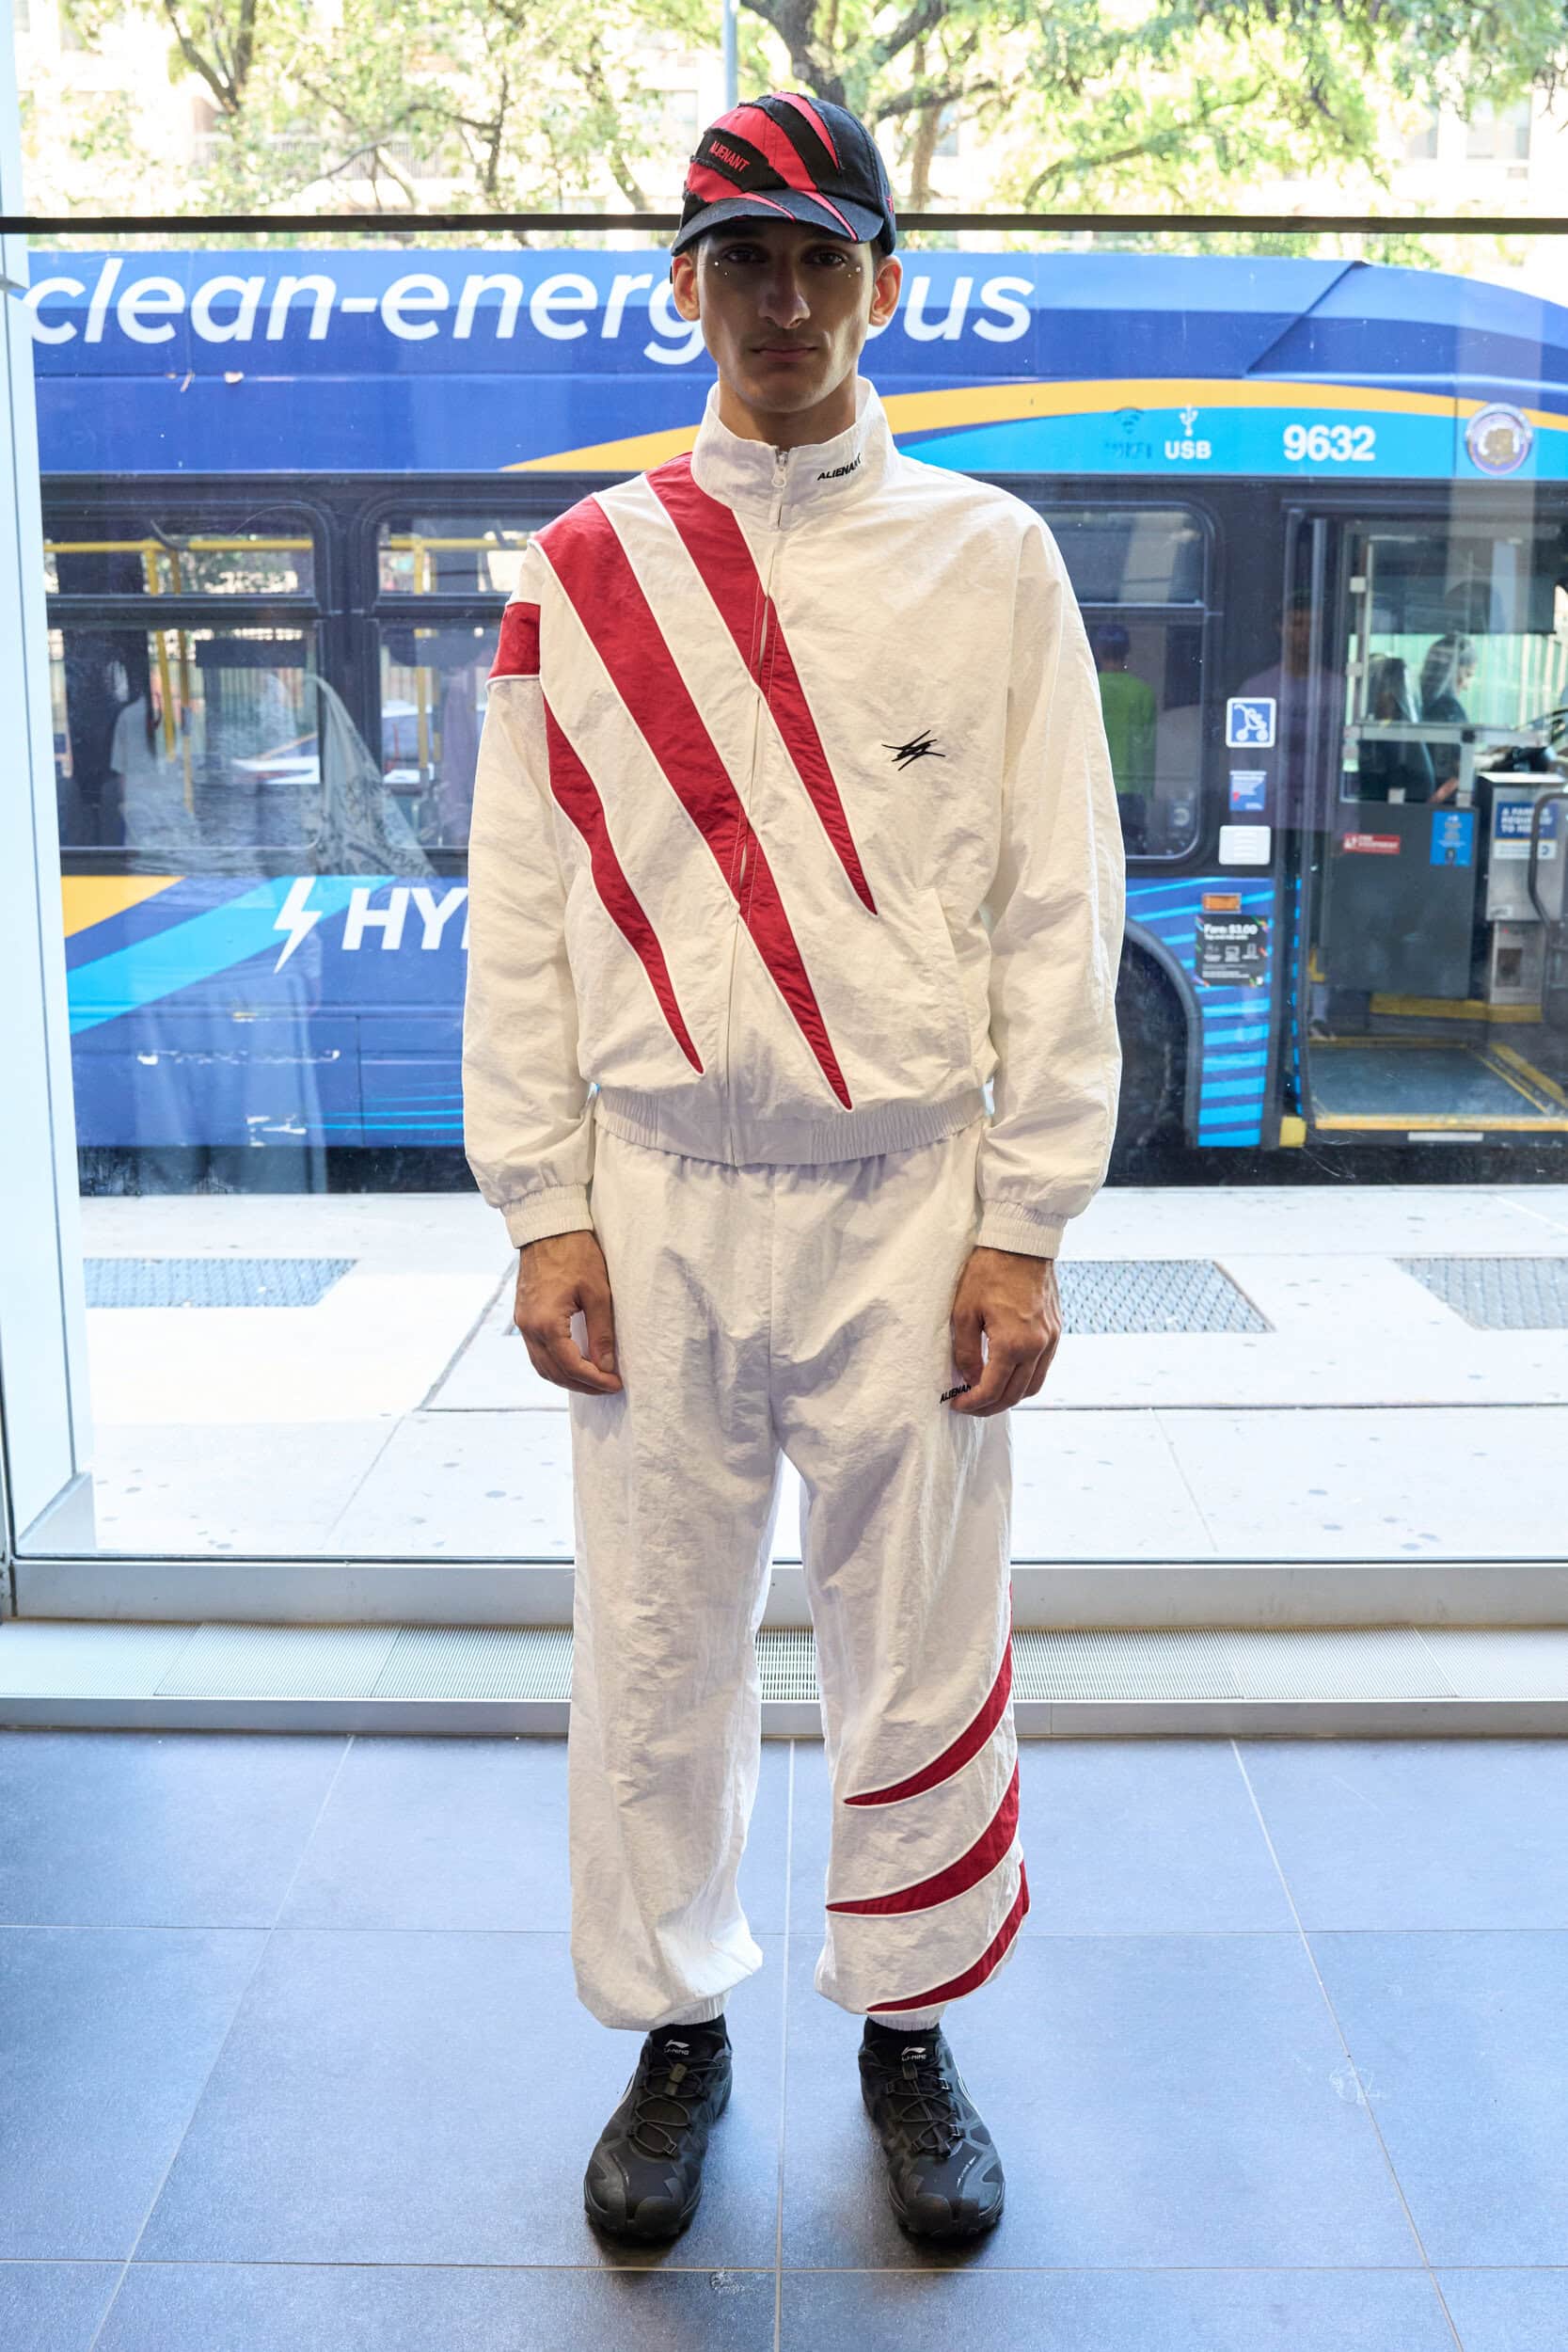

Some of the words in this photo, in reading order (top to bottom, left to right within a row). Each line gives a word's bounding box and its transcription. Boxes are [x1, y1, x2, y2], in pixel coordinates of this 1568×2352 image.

[23, 257, 707, 366] clean-energ
[865, 276, 1036, 343] us
[1164, 439, 1212, 460] USB
[1282, 424, 1377, 462] 9632
[341, 886, 469, 950] HY
